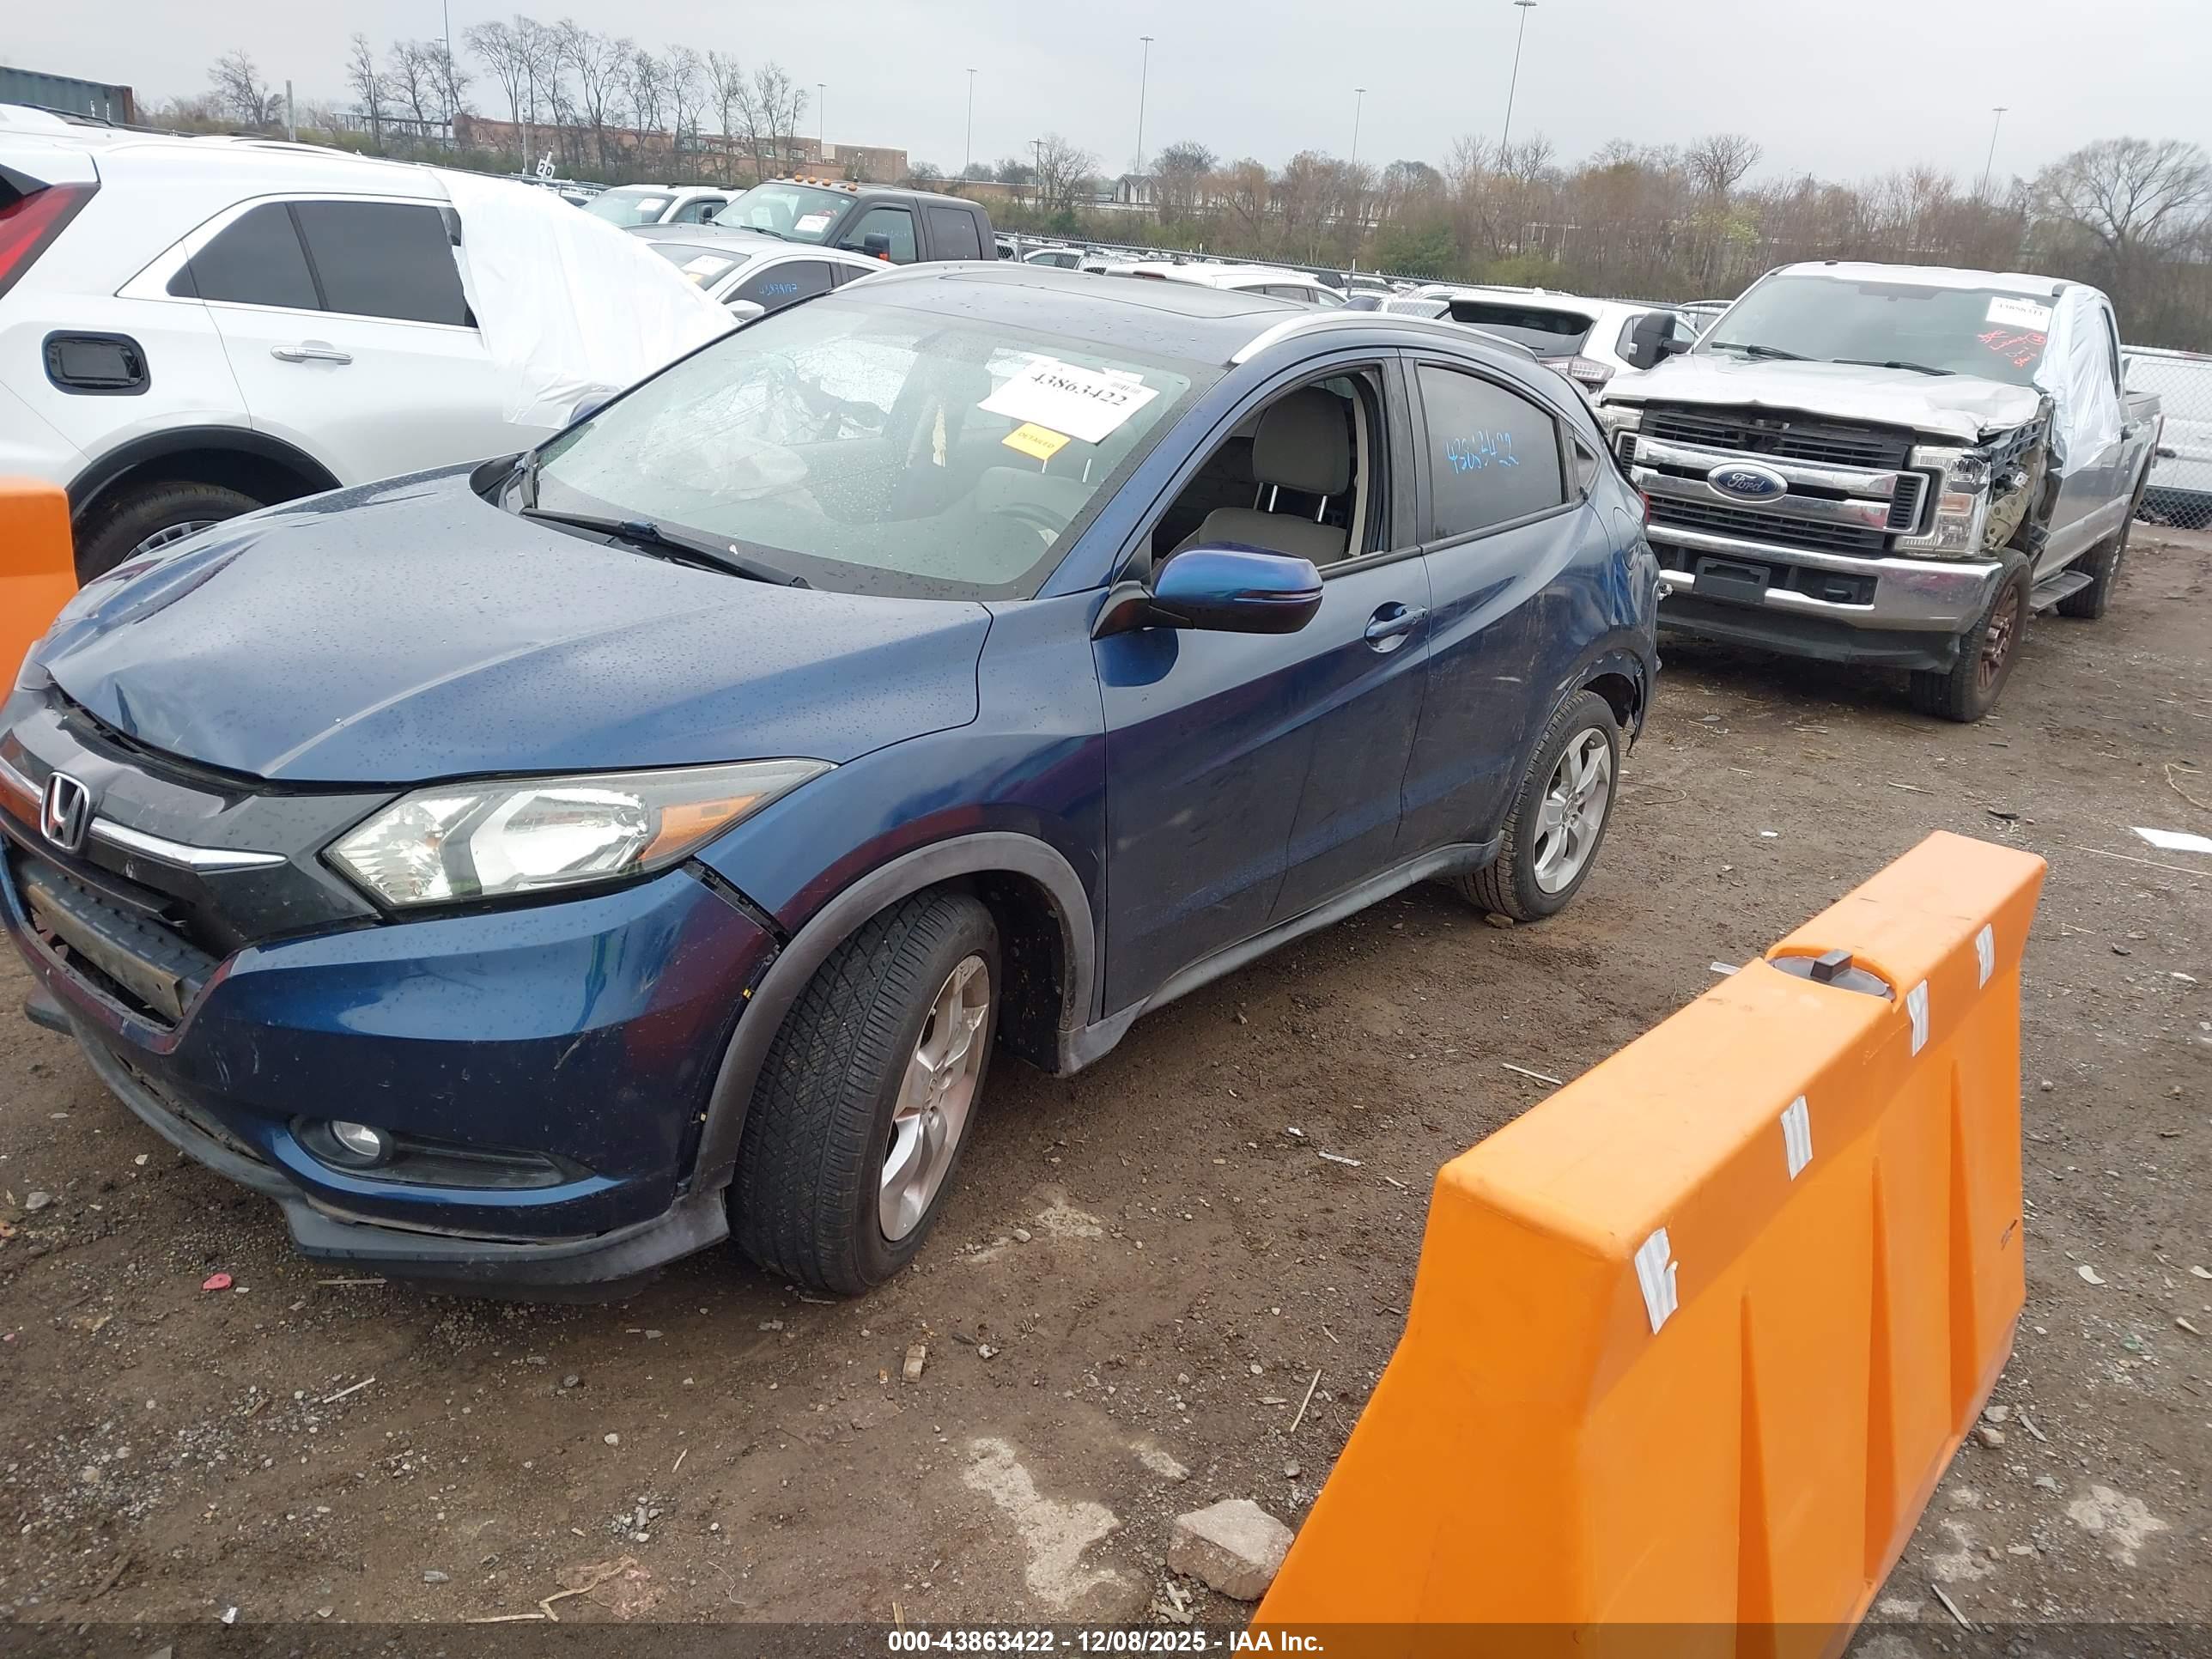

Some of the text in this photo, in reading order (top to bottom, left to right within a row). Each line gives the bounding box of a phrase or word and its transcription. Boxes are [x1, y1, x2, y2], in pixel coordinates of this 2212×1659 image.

[538, 162, 553, 177] 20
[1030, 373, 1127, 406] 43863422
[1726, 472, 1765, 492] Ford
